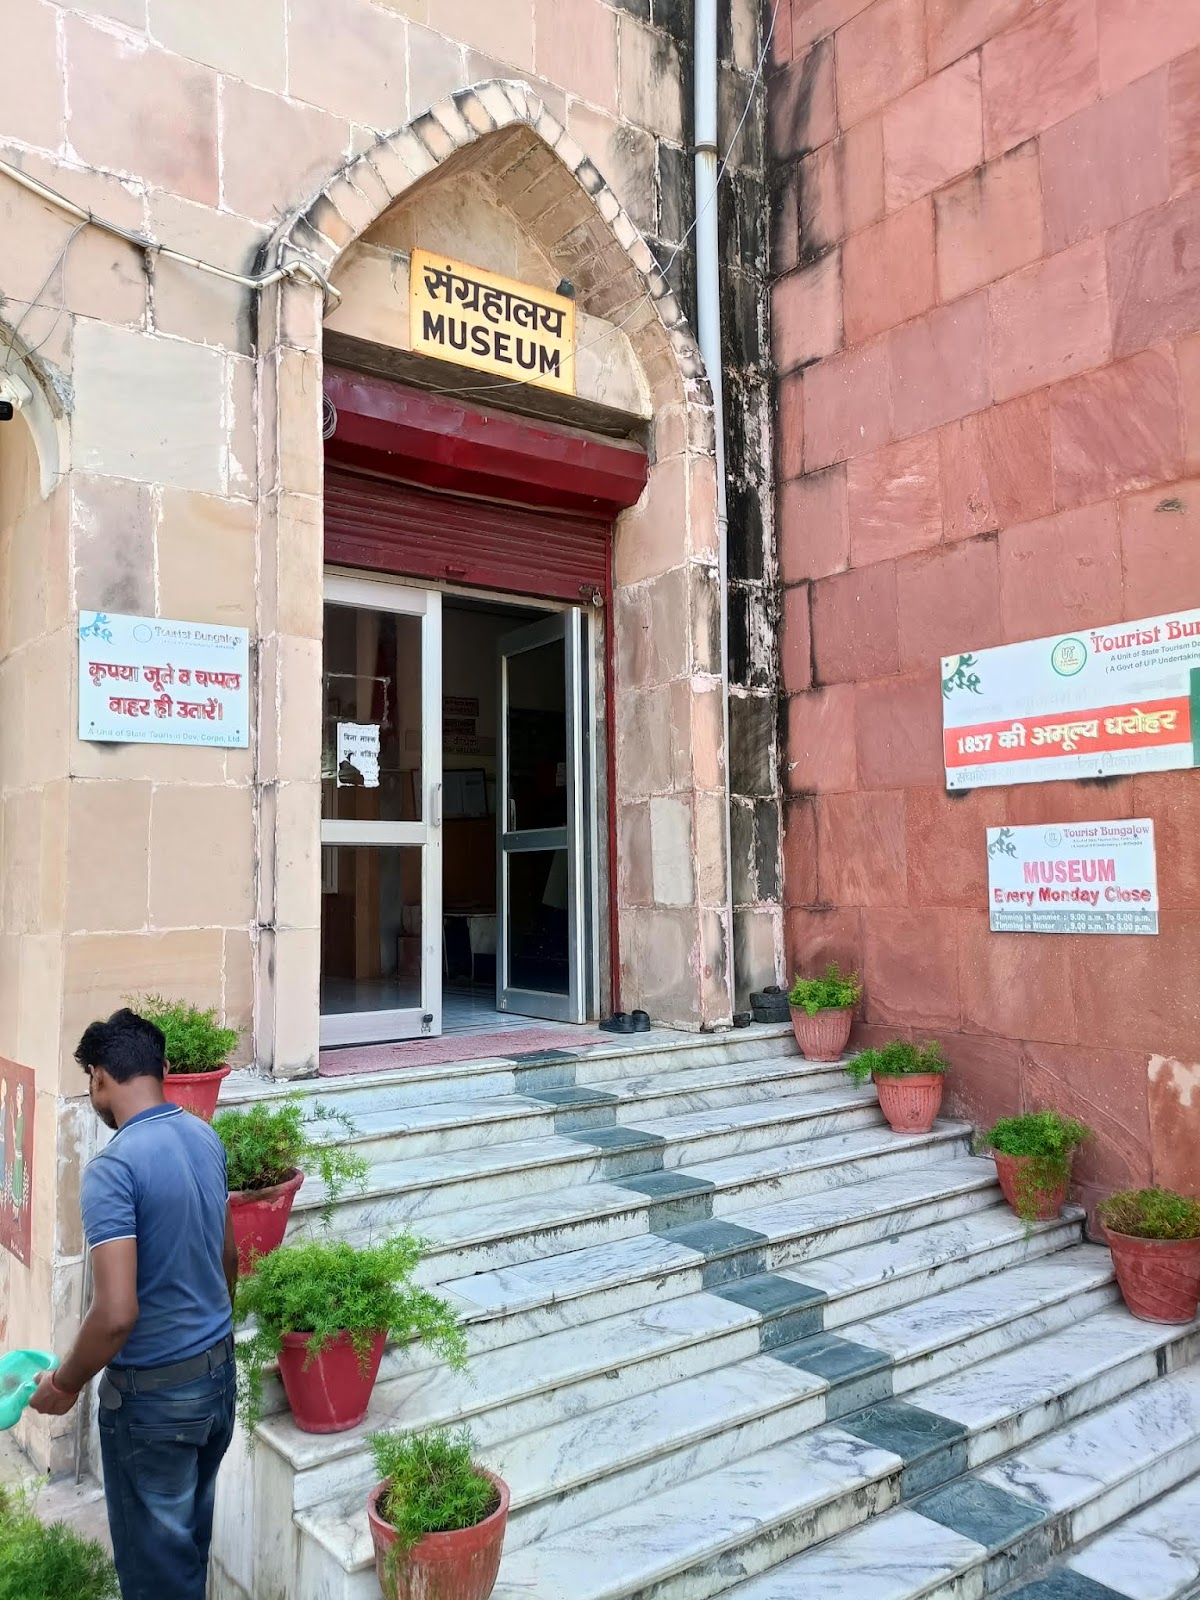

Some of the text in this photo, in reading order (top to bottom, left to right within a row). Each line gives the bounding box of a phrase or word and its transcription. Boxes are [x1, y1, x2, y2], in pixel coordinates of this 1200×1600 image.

[423, 264, 566, 338] संग्रहालय
[422, 310, 560, 378] MUSEUM
[154, 626, 193, 638] Tourist
[1090, 625, 1160, 653] Tourist
[1110, 654, 1116, 662] A
[1117, 652, 1131, 662] Unit
[1133, 650, 1140, 658] of
[1141, 648, 1160, 658] State
[1161, 642, 1190, 654] Tourism
[88, 661, 140, 686] कृपया
[142, 663, 175, 692] जूते
[195, 670, 242, 691] चप्पल
[1116, 662, 1134, 672] Govt
[154, 694, 174, 719] ही
[115, 728, 124, 737] of
[957, 708, 1179, 754] 1857 की अमूल्य धरोहर
[1063, 828, 1098, 839] Tourist
[1099, 824, 1150, 838] Bungalow
[1023, 858, 1116, 884] MUSEUM
[994, 886, 1152, 907] Every Monday Close
[1033, 913, 1061, 921] Summer
